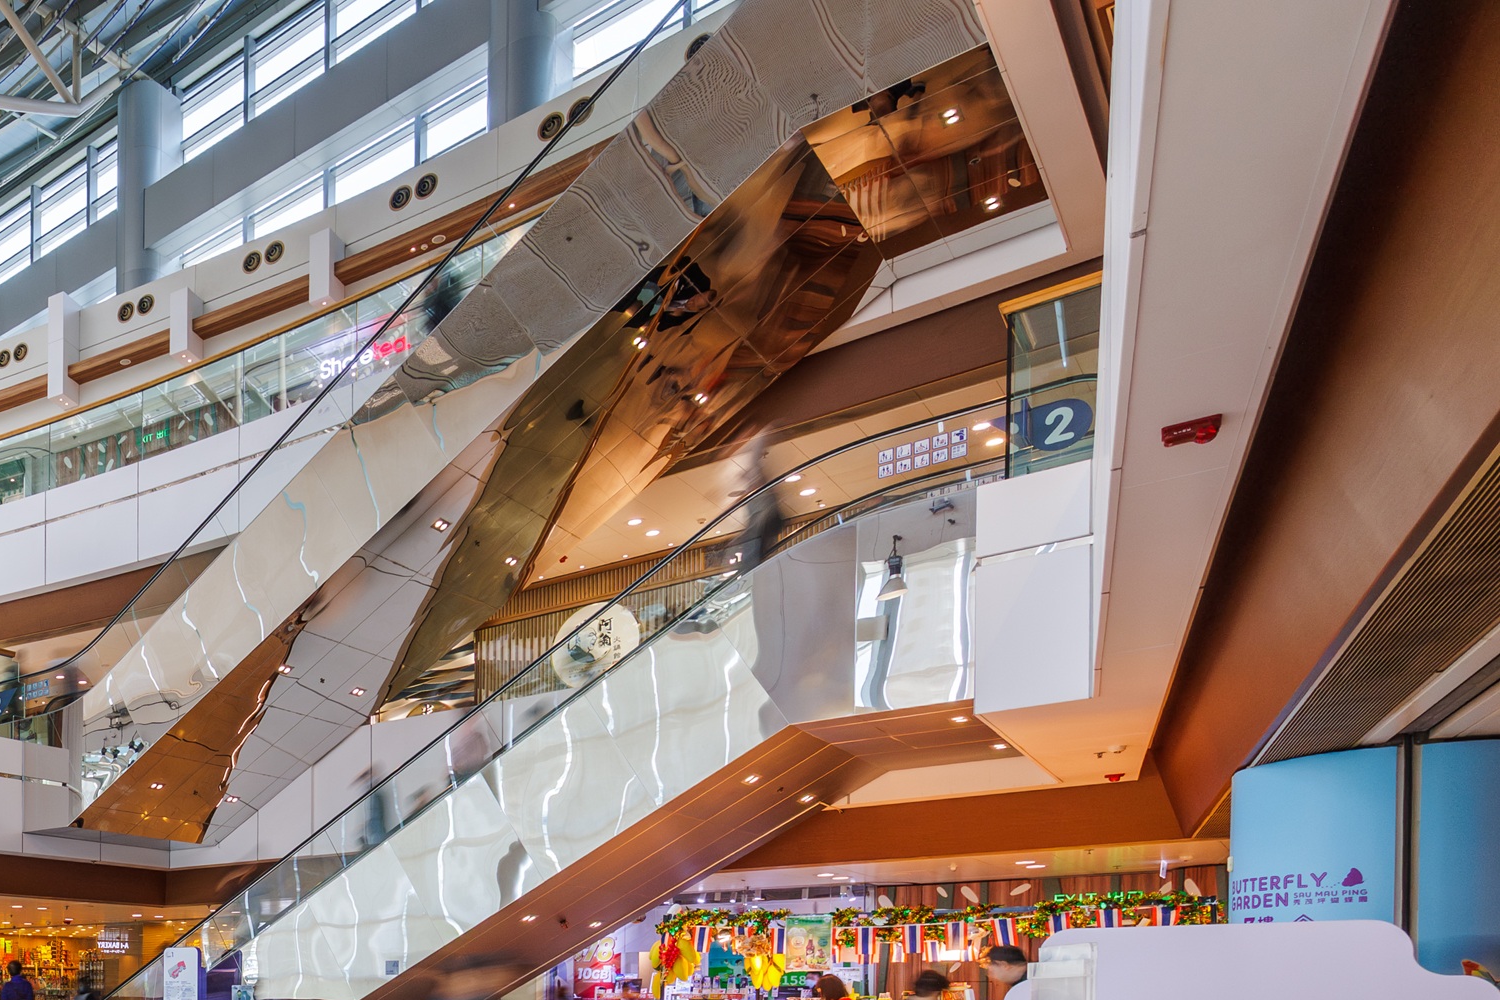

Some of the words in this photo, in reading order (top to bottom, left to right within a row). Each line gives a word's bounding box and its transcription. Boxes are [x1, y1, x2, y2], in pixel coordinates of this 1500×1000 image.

[1044, 406, 1074, 445] 2
[1232, 872, 1327, 895] BUTTERFLY
[1342, 888, 1368, 896] PING
[1053, 892, 1096, 902] EXIT
[1232, 892, 1289, 911] GARDEN
